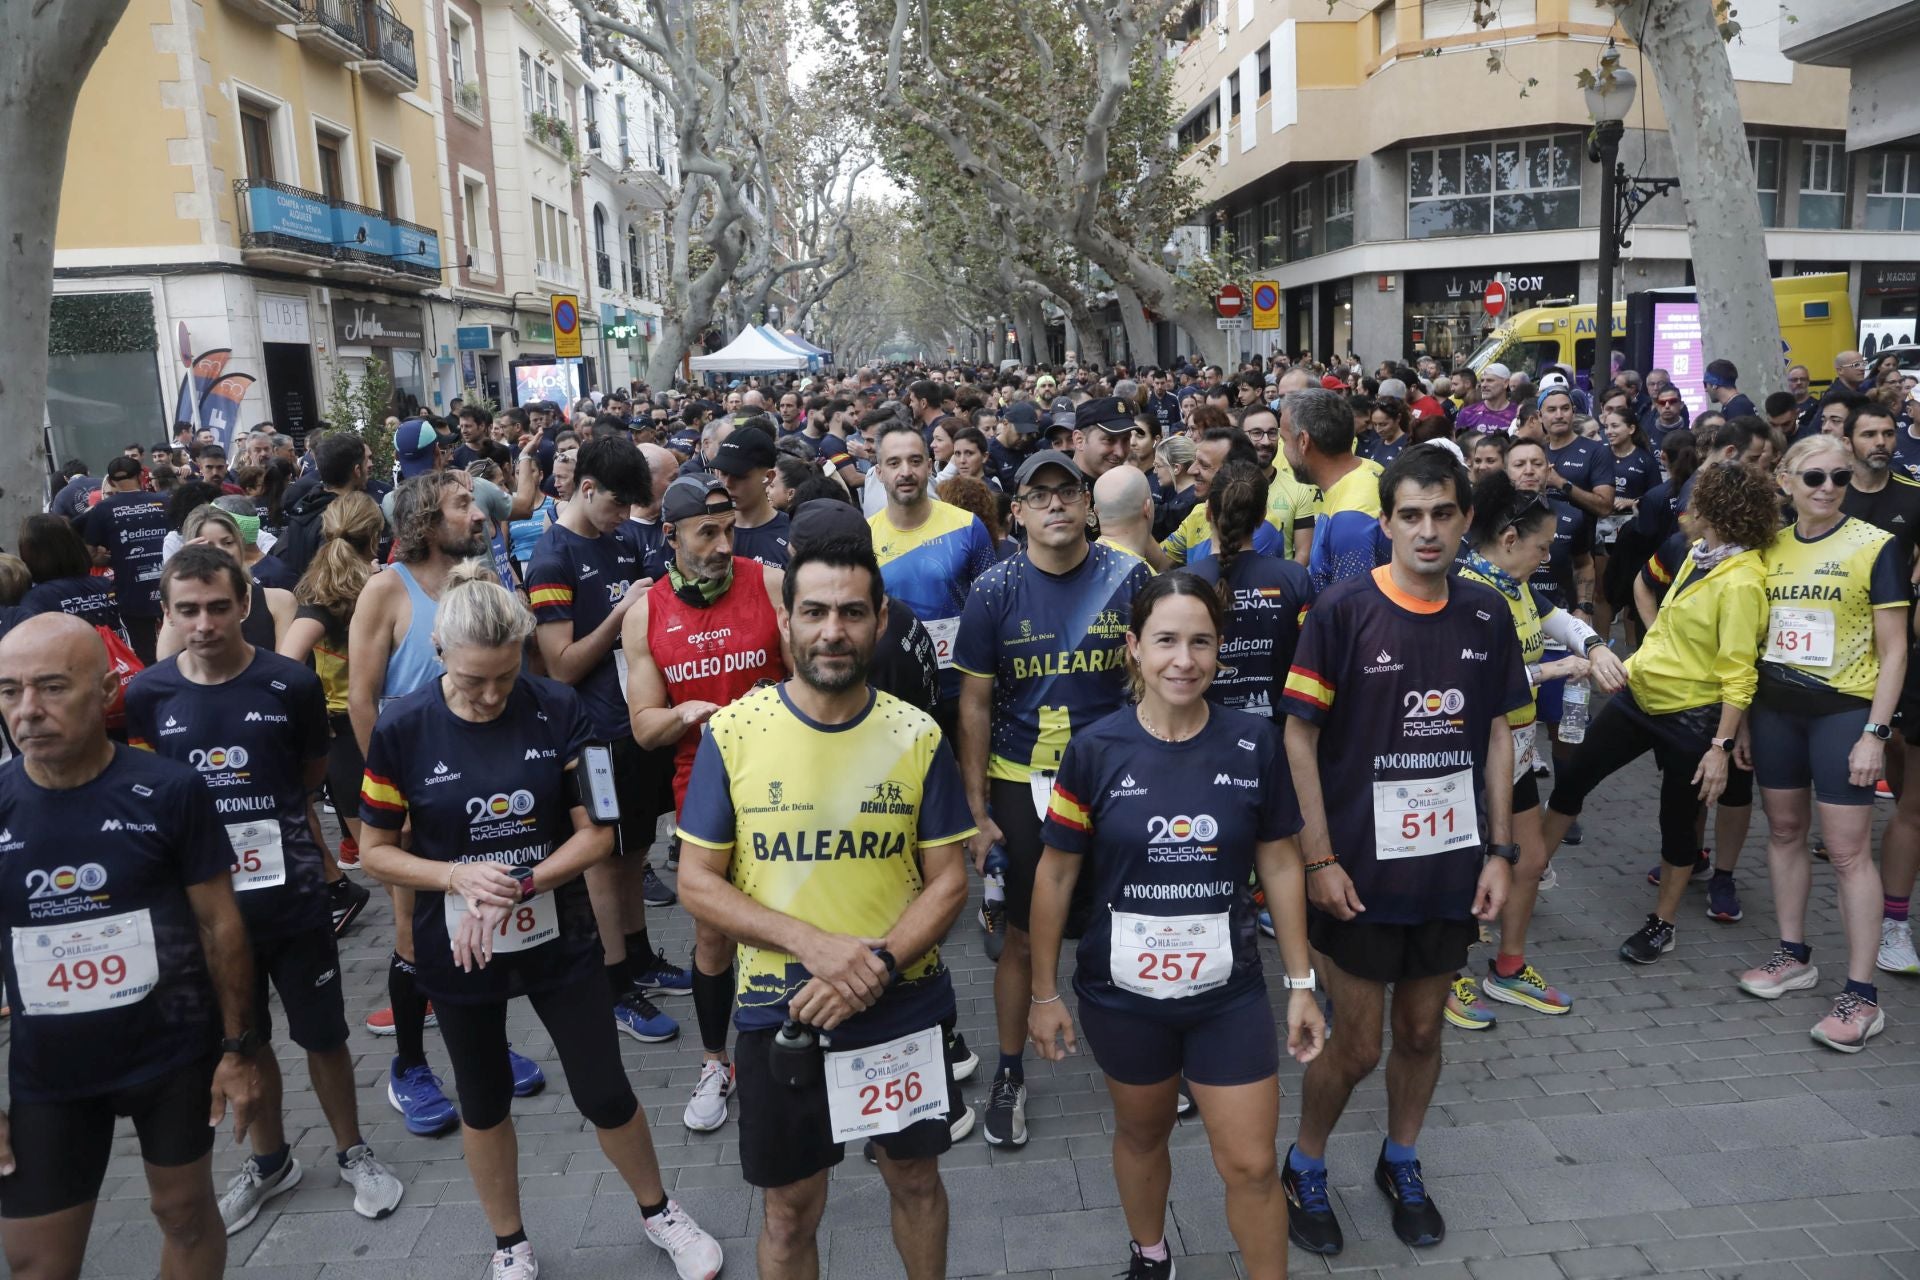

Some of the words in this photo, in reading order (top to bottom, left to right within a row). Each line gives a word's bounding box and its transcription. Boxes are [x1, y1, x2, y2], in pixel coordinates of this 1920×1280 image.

[1886, 272, 1917, 282] MACSON
[1469, 276, 1543, 294] MASON
[112, 503, 154, 513] POLICIA
[114, 507, 165, 518] NACIONAL
[128, 528, 167, 539] edicom
[1234, 588, 1263, 599] CIA
[1232, 598, 1282, 610] ONAL
[687, 628, 732, 644] excom
[1775, 630, 1812, 652] 431
[1220, 637, 1273, 653] edicom
[664, 657, 721, 684] NUCLEO
[725, 649, 767, 673] DURO
[1363, 663, 1405, 674] Santander
[1403, 688, 1465, 718] 200
[264, 713, 288, 724] mupol
[1403, 719, 1452, 729] POLICIA
[160, 726, 188, 737] Santander
[1403, 728, 1464, 737] NACIONAL
[189, 745, 249, 772] 200
[203, 772, 238, 781] LICIA
[206, 778, 252, 788] CIONAL
[424, 772, 462, 786] Santander
[1233, 778, 1259, 789] mupol
[1110, 787, 1148, 798] Santander
[215, 795, 276, 814] OCONLUCA
[465, 789, 535, 824] 200
[780, 804, 790, 812] de
[792, 803, 814, 811] Dénia
[890, 803, 915, 816] CORRE
[126, 822, 157, 833] mupol
[469, 819, 523, 834] POLICIA
[1147, 814, 1218, 844] 200
[1401, 807, 1454, 839] 511
[471, 826, 537, 842] NACIONAL
[1147, 846, 1204, 855] POLICIA
[1147, 854, 1217, 863] NACIONAL
[25, 862, 107, 900] 200
[28, 896, 93, 911] POLICIA
[30, 902, 111, 919] NACIONAL
[47, 954, 127, 993] 499
[1137, 952, 1207, 982] 257
[859, 1071, 923, 1116] 256
